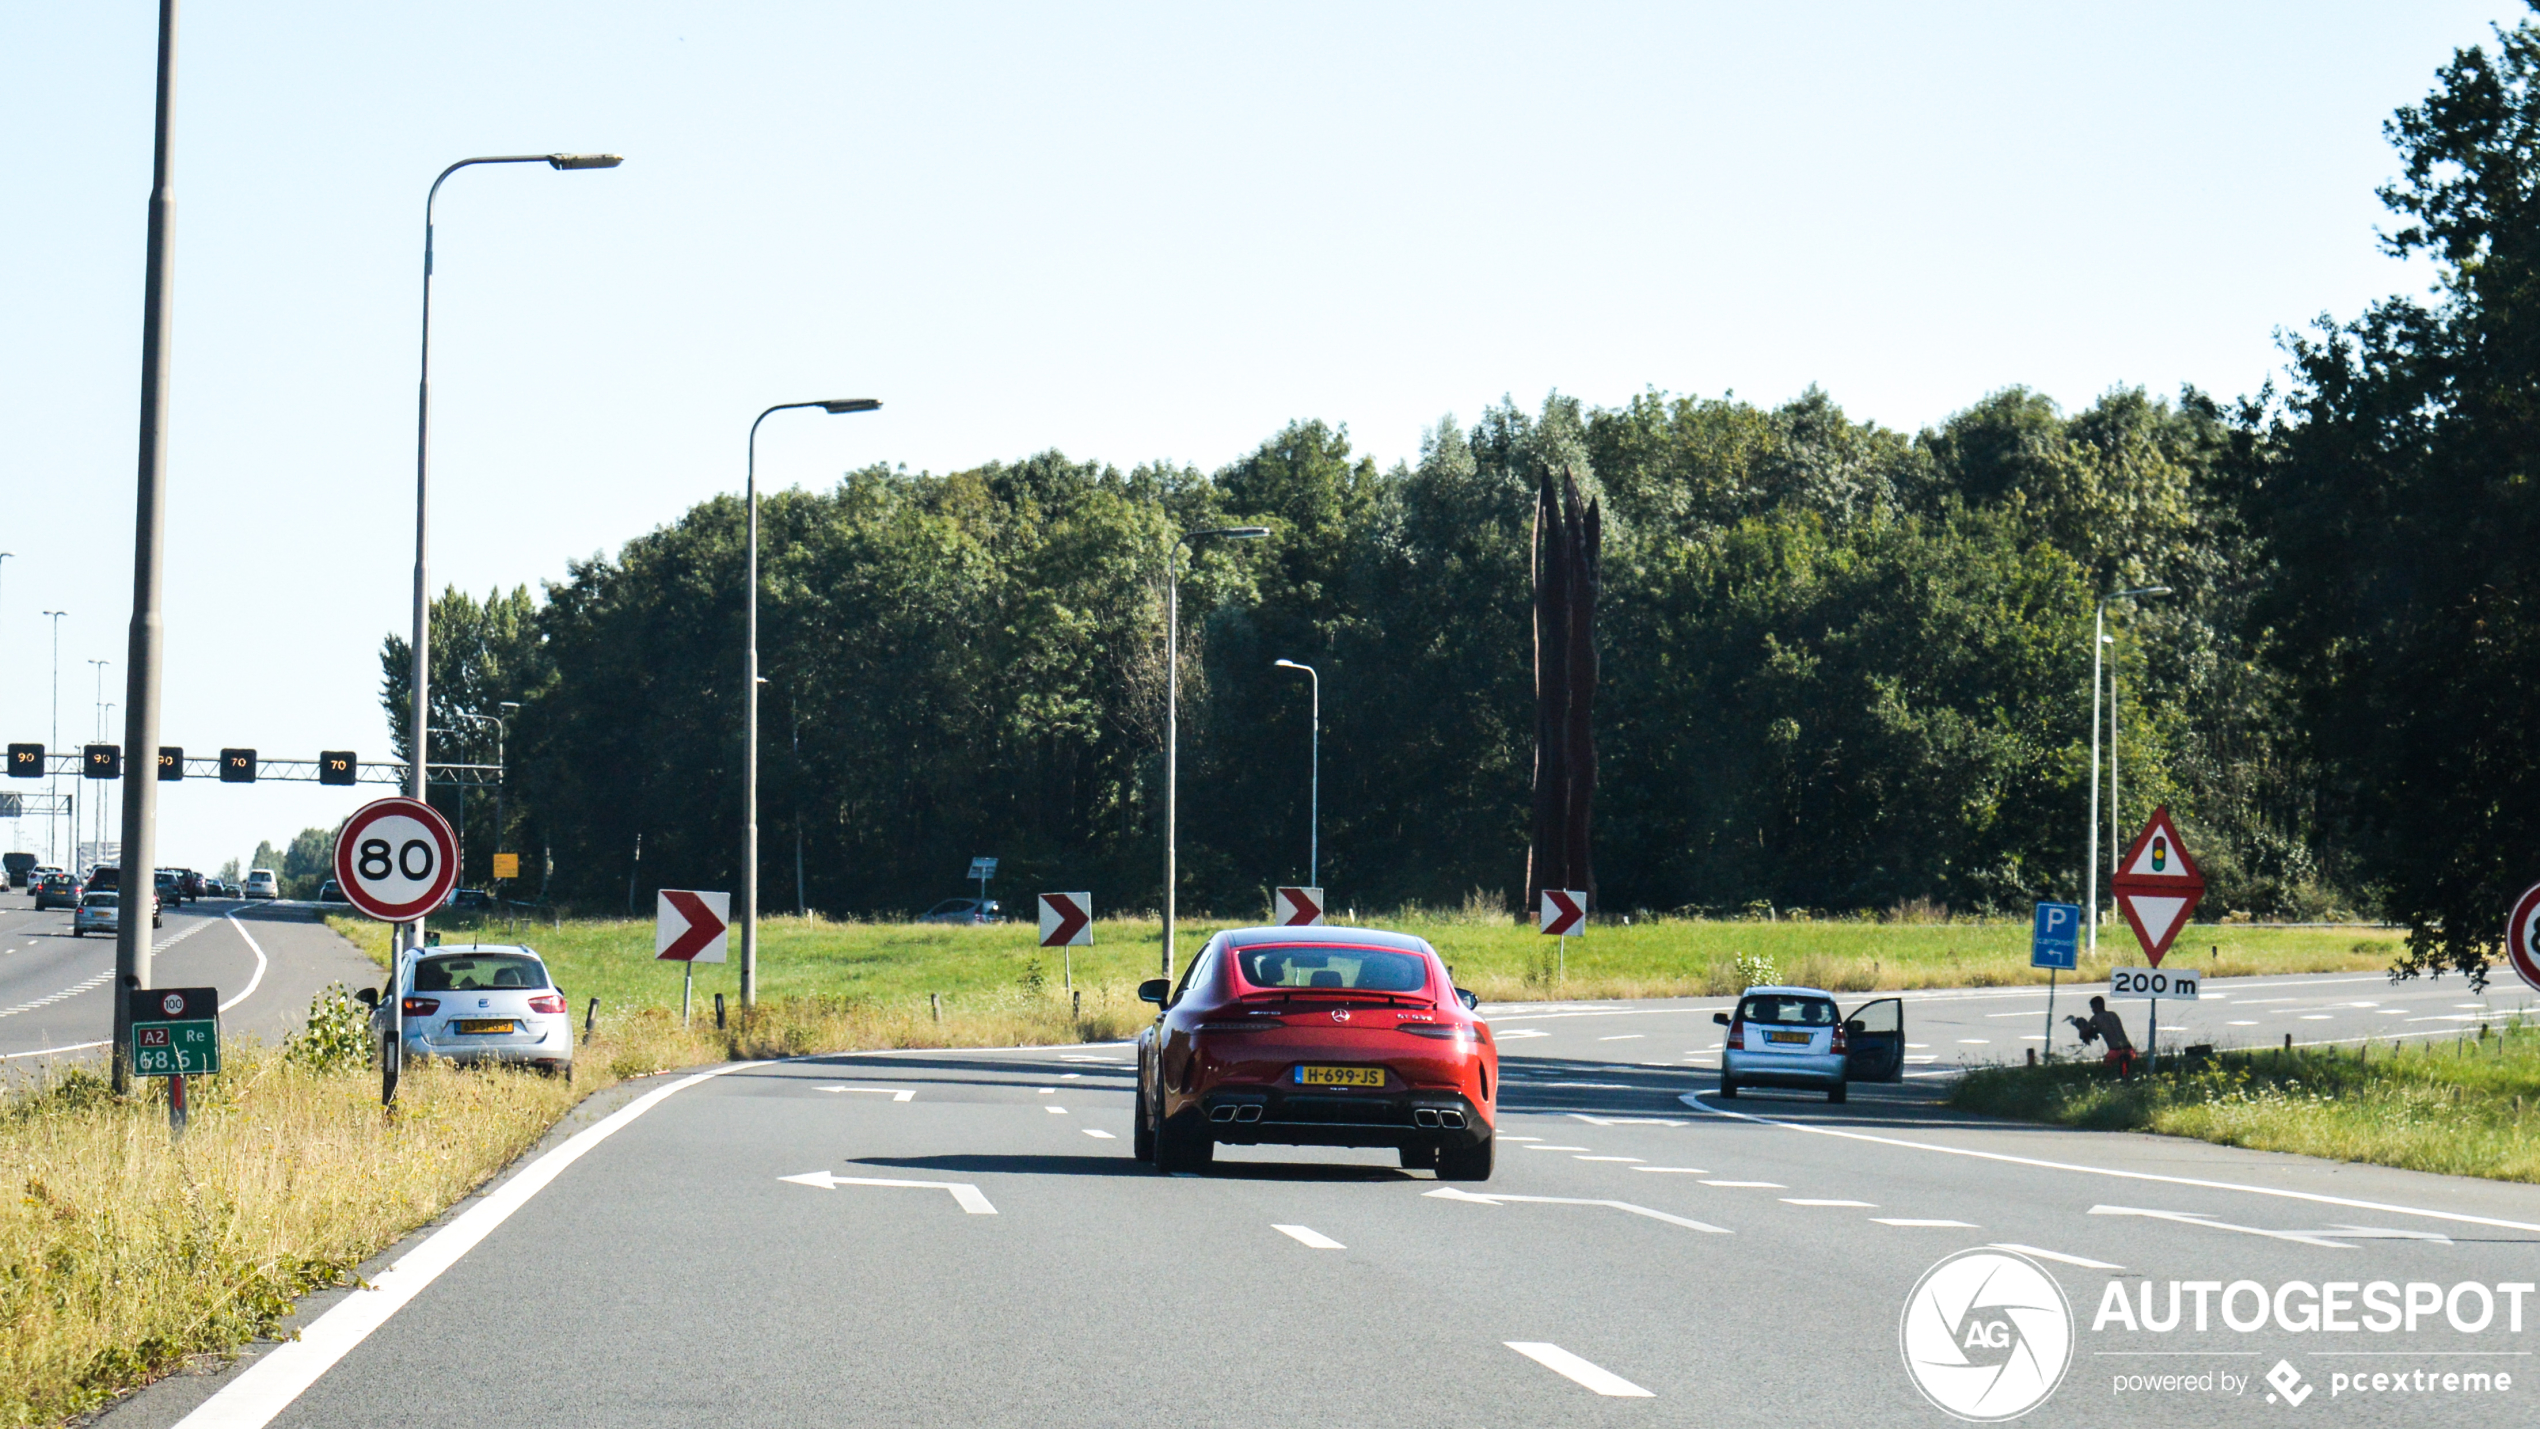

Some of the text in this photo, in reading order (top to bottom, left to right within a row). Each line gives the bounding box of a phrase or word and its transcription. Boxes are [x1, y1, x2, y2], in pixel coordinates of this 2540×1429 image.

[17, 752, 35, 763] 90
[93, 754, 111, 764] 90
[231, 757, 247, 767] 70
[330, 760, 347, 770] 70
[358, 838, 434, 881] 80
[2047, 908, 2067, 933] P
[2115, 973, 2196, 994] 200 m
[165, 999, 182, 1010] 100
[144, 1029, 205, 1044] A2 Re
[139, 1049, 191, 1071] 68,6
[1308, 1068, 1378, 1084] H-699-JS
